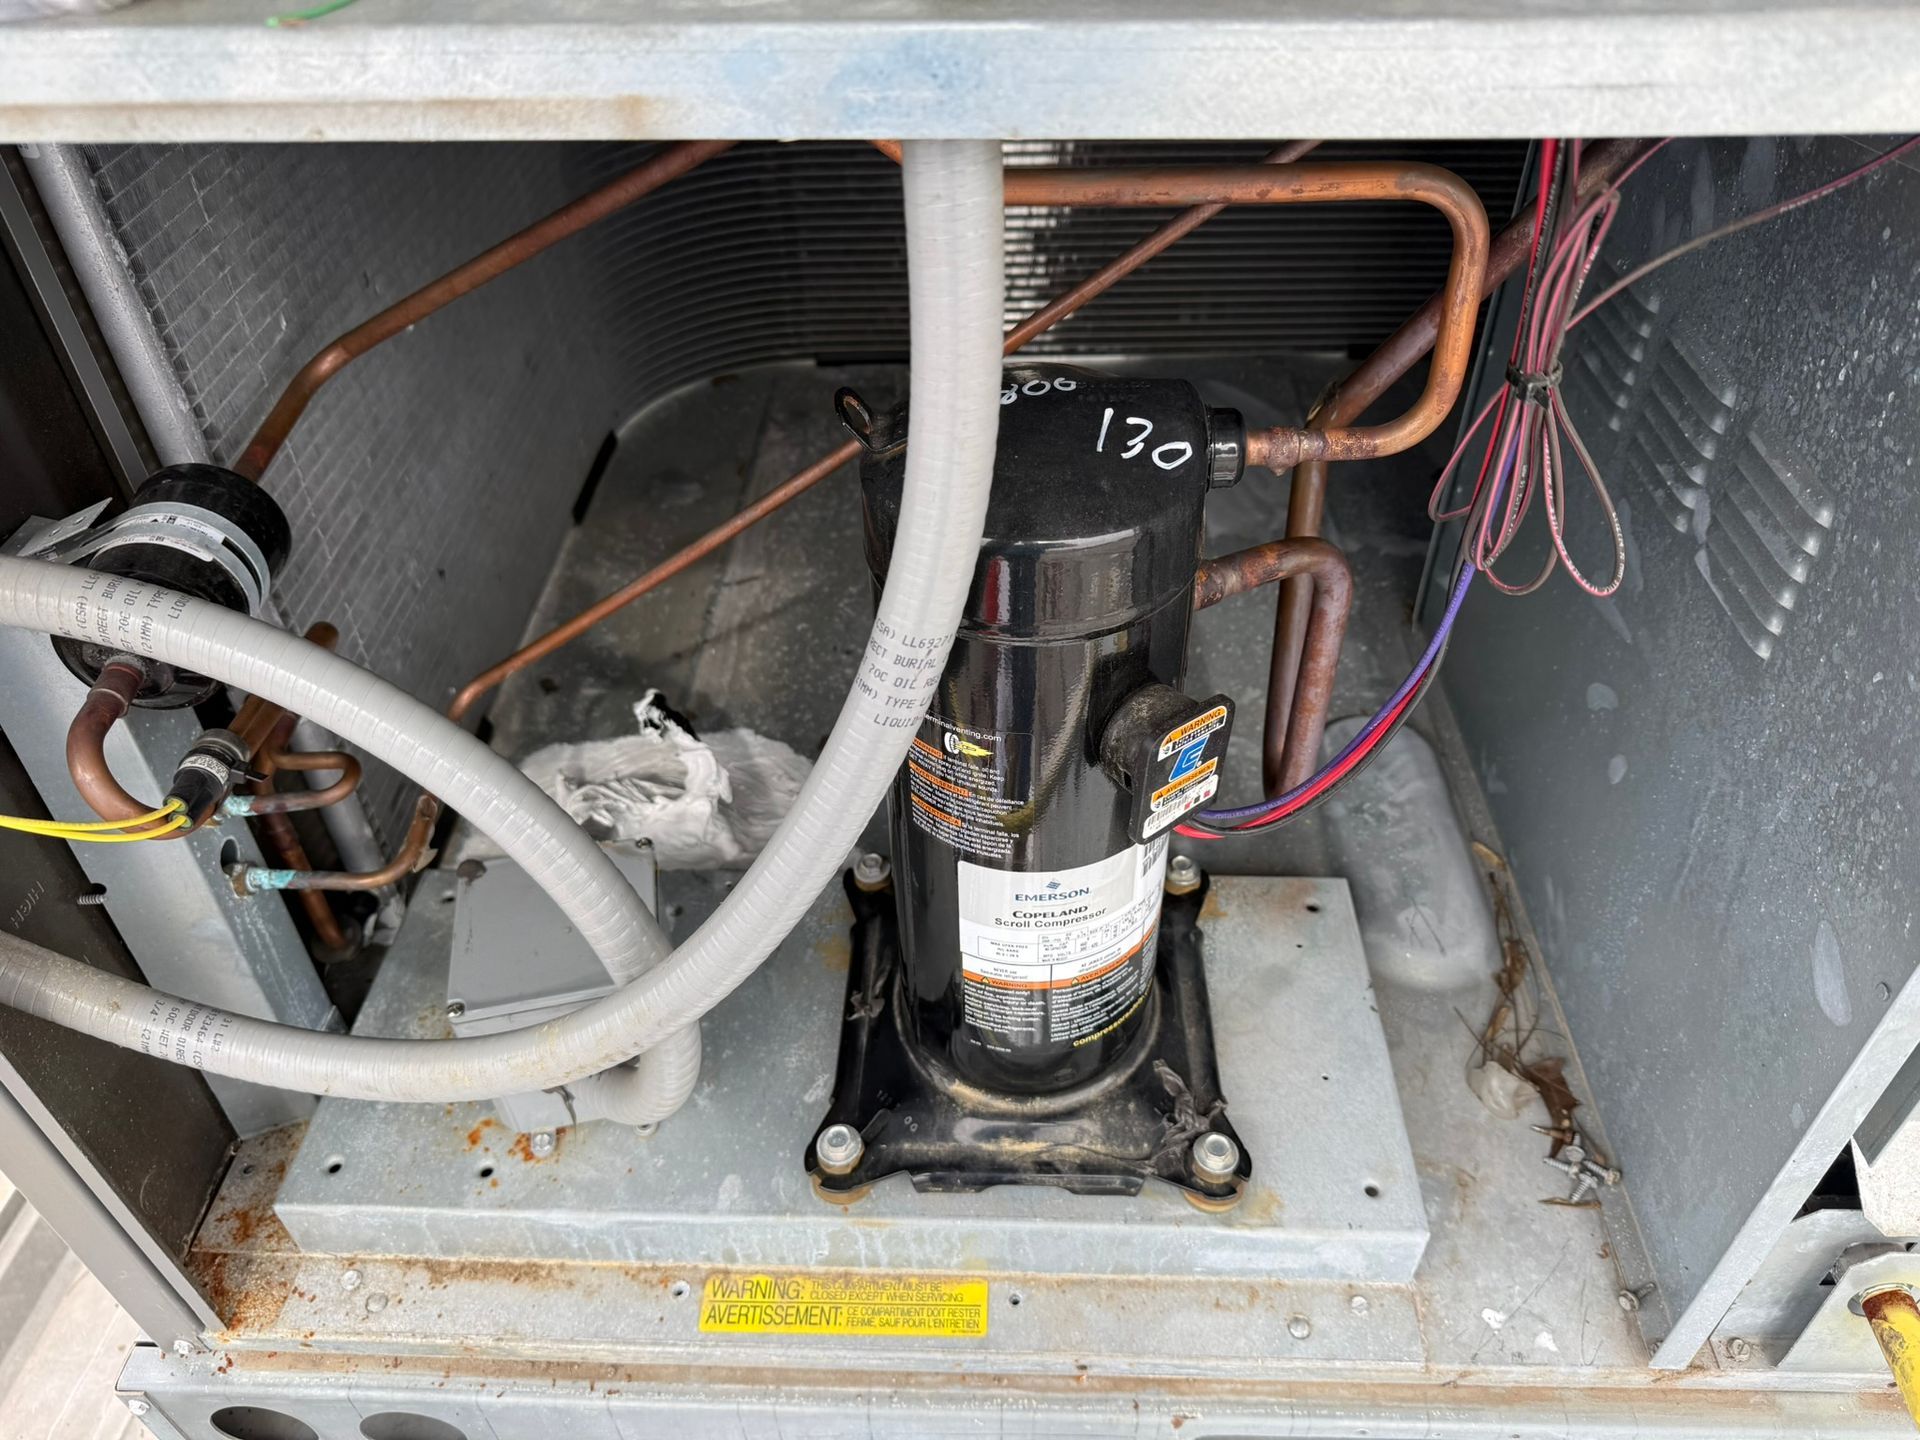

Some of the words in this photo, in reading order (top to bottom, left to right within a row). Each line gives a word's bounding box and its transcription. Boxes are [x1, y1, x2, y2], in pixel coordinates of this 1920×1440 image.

[1096, 407, 1193, 470] 130
[893, 653, 937, 670] BURIAL
[885, 695, 917, 709] TYPE
[1180, 708, 1221, 736] WARNING
[1015, 886, 1090, 902] EMERSON
[994, 917, 1030, 928] Scroll
[1034, 906, 1107, 928] Compressor
[992, 980, 1027, 988] WARNING
[711, 1279, 806, 1300] WARNING:
[811, 1280, 831, 1290] THIS
[902, 1281, 928, 1292] MUST
[930, 1282, 942, 1292] BE
[809, 1291, 848, 1301] CLOSED
[849, 1291, 885, 1302] EXCEPT
[886, 1292, 914, 1302] WHEN
[915, 1293, 964, 1303] SERVICING
[705, 1303, 843, 1327] AVERTISSEMENT:
[847, 1306, 859, 1316] CE
[860, 1306, 925, 1318] COMPARTIMENT
[926, 1307, 947, 1318] DOIT
[948, 1308, 981, 1319] RESTER
[879, 1317, 901, 1328] SAUF
[902, 1317, 926, 1328] POUR
[927, 1318, 980, 1329] L'ENTRETIEN
